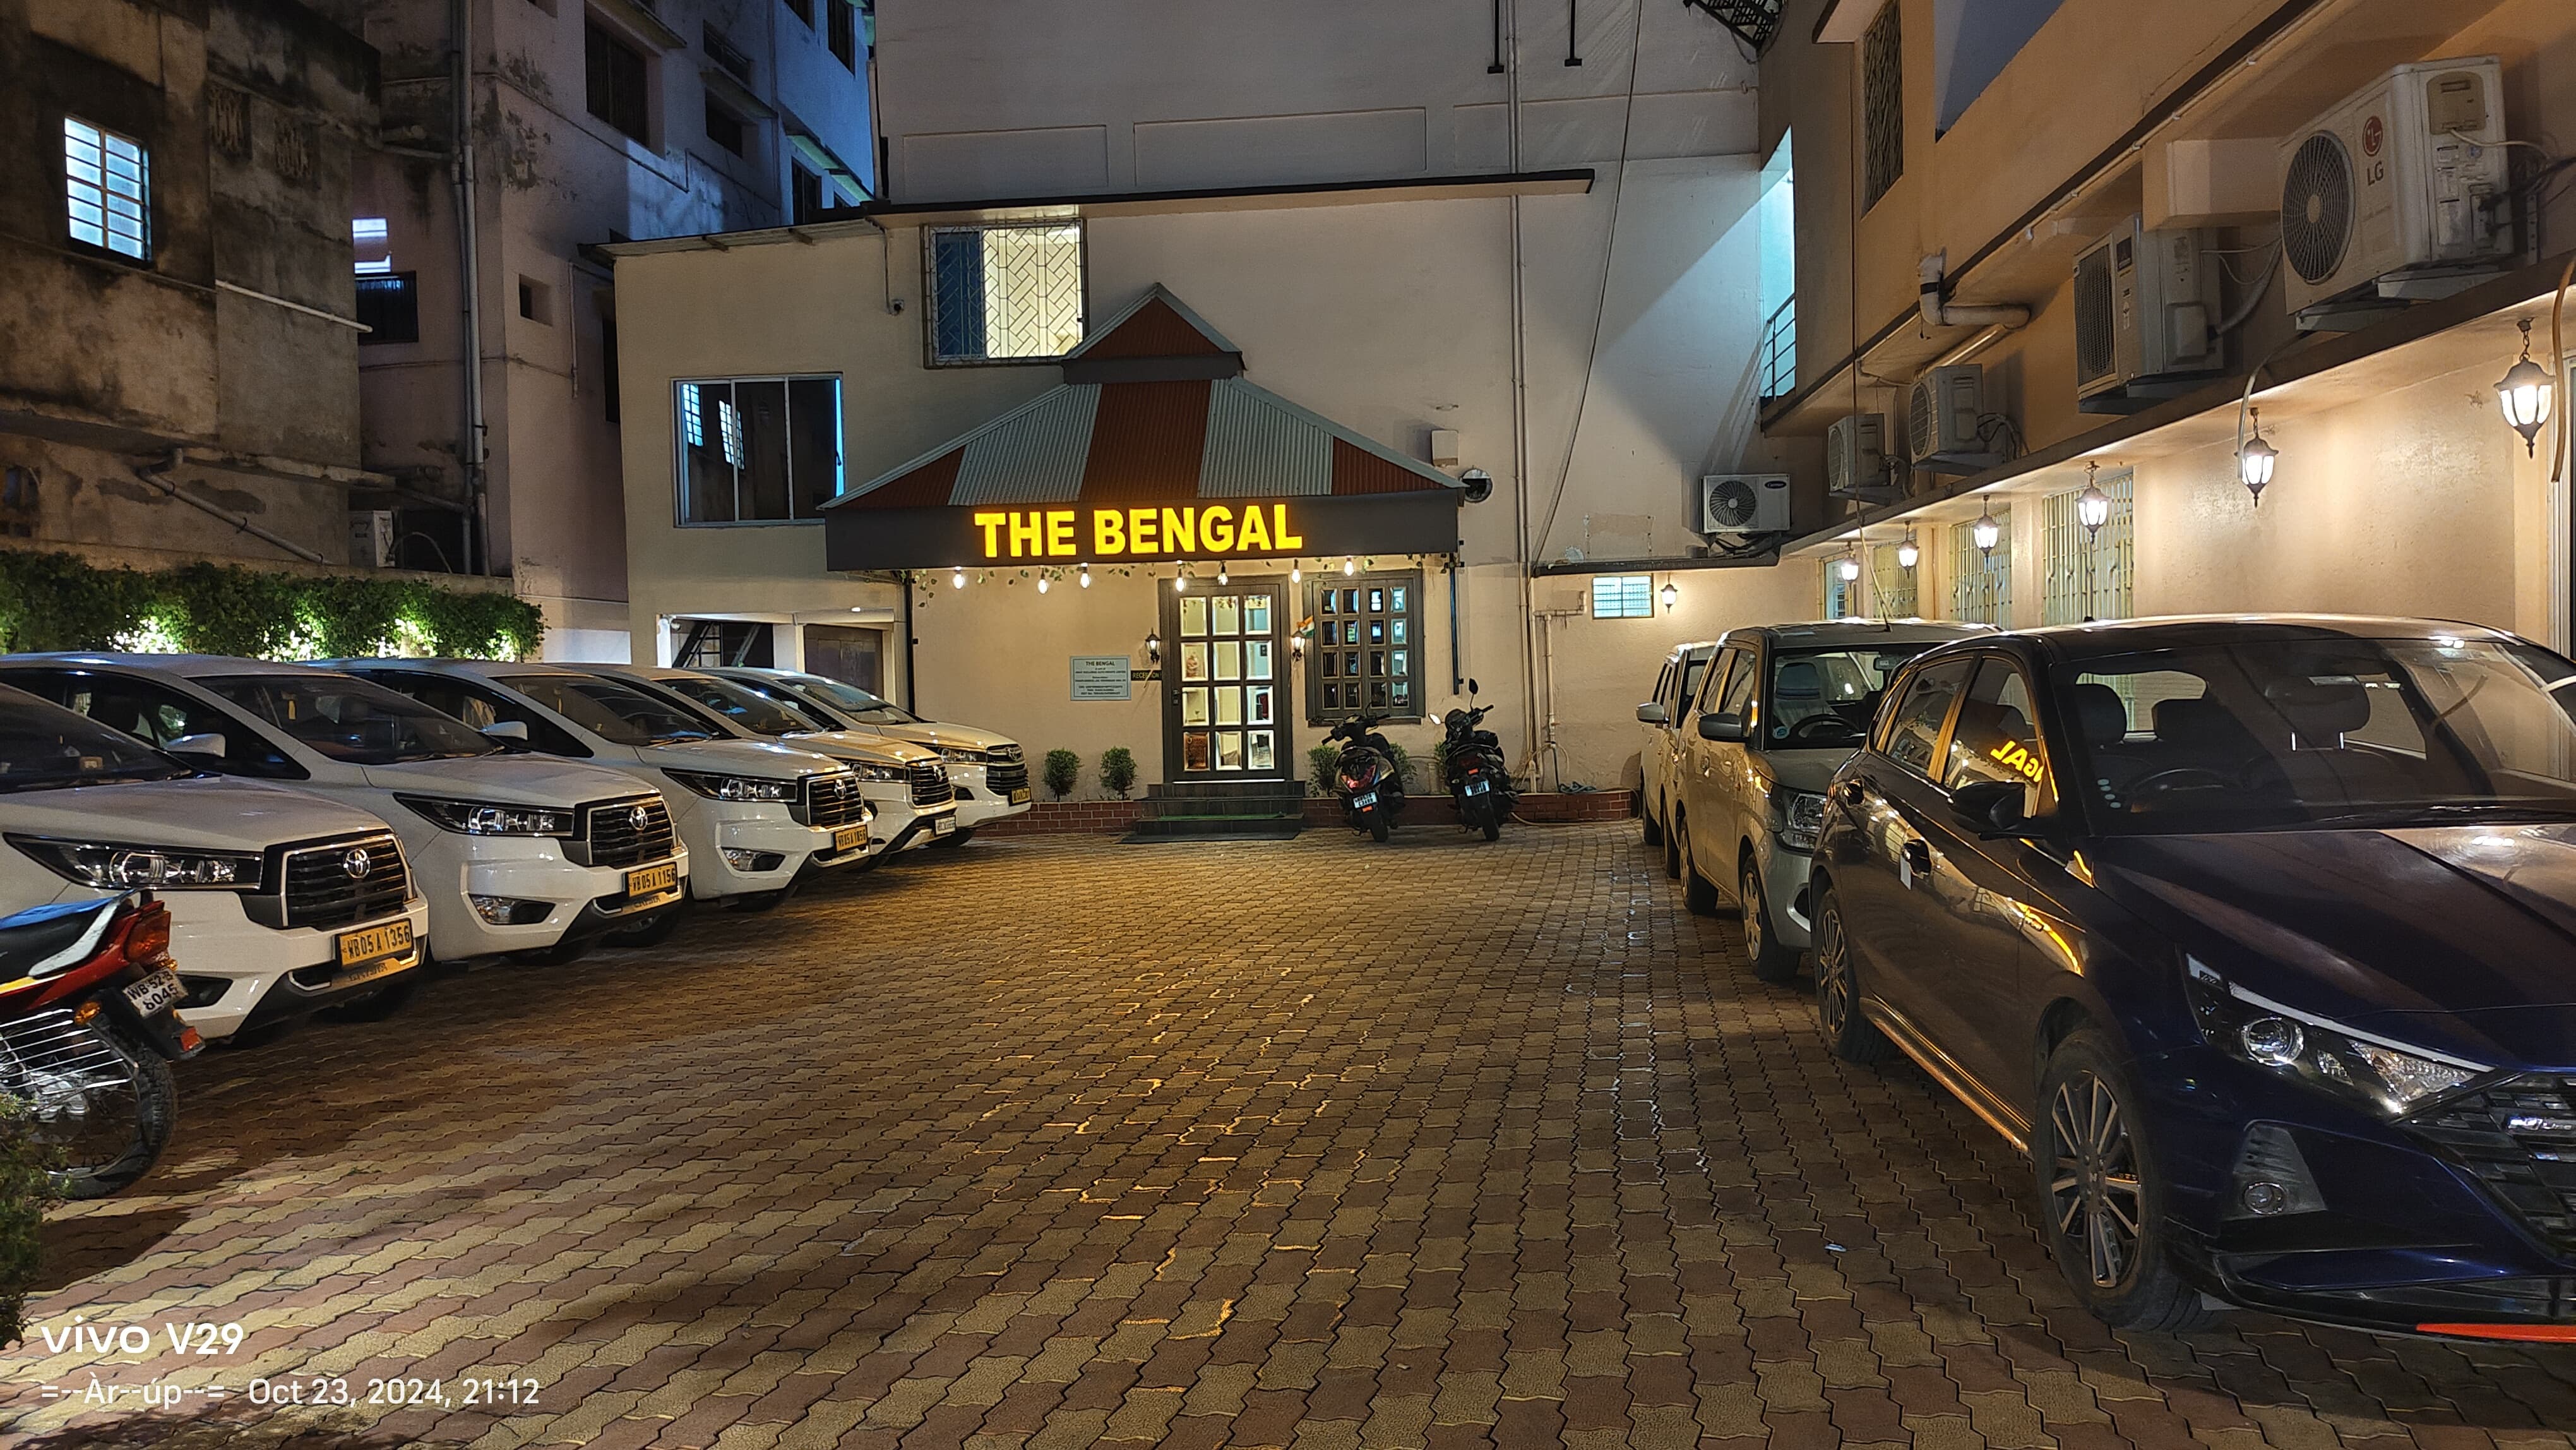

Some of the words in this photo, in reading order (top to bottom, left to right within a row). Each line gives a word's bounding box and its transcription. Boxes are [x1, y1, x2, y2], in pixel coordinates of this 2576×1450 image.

[2366, 160, 2384, 186] LG
[974, 510, 1076, 558] THE
[1094, 504, 1303, 554] BENGAL
